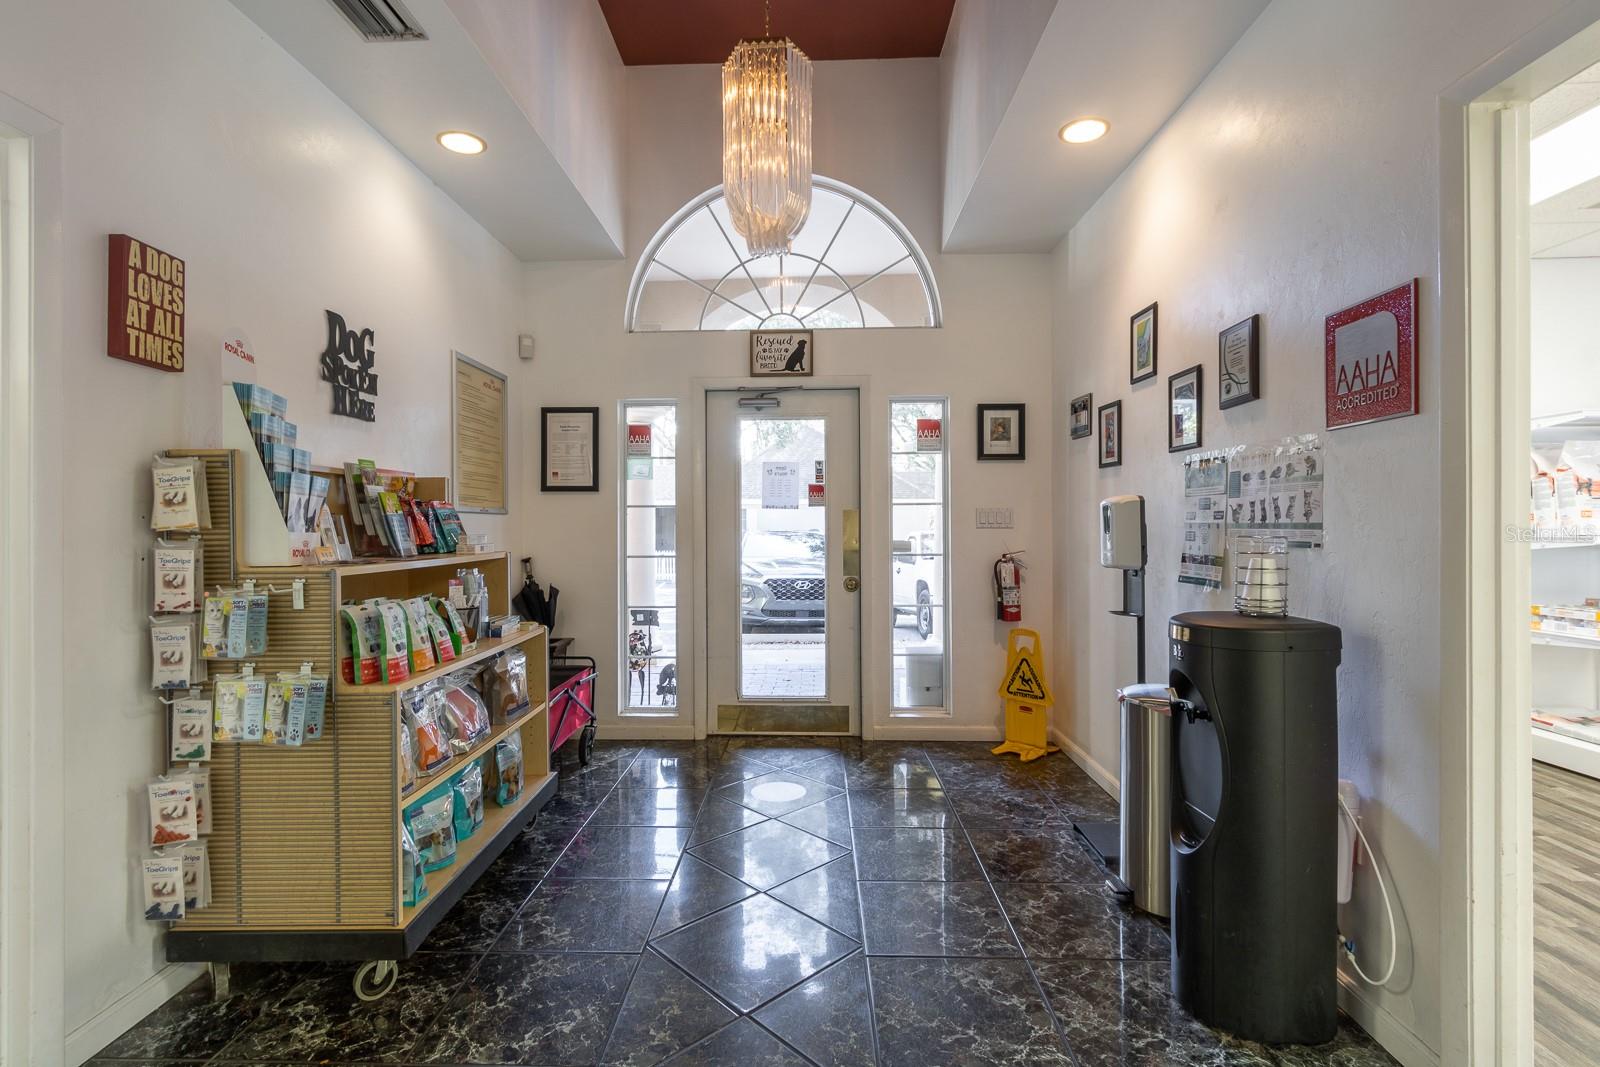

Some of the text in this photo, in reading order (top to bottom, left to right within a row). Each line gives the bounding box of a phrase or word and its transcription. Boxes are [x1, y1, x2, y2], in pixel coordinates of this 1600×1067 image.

[128, 240, 183, 287] A DOG
[128, 269, 183, 315] LOVES
[126, 302, 183, 342] AT ALL
[127, 328, 183, 370] TIMES
[756, 335, 793, 347] Rescued
[1336, 350, 1398, 395] AAHA
[1335, 385, 1398, 411] ACCREDITED
[629, 435, 650, 444] AAHA
[917, 429, 940, 439] AAHA
[1012, 691, 1039, 700] ATTENTION
